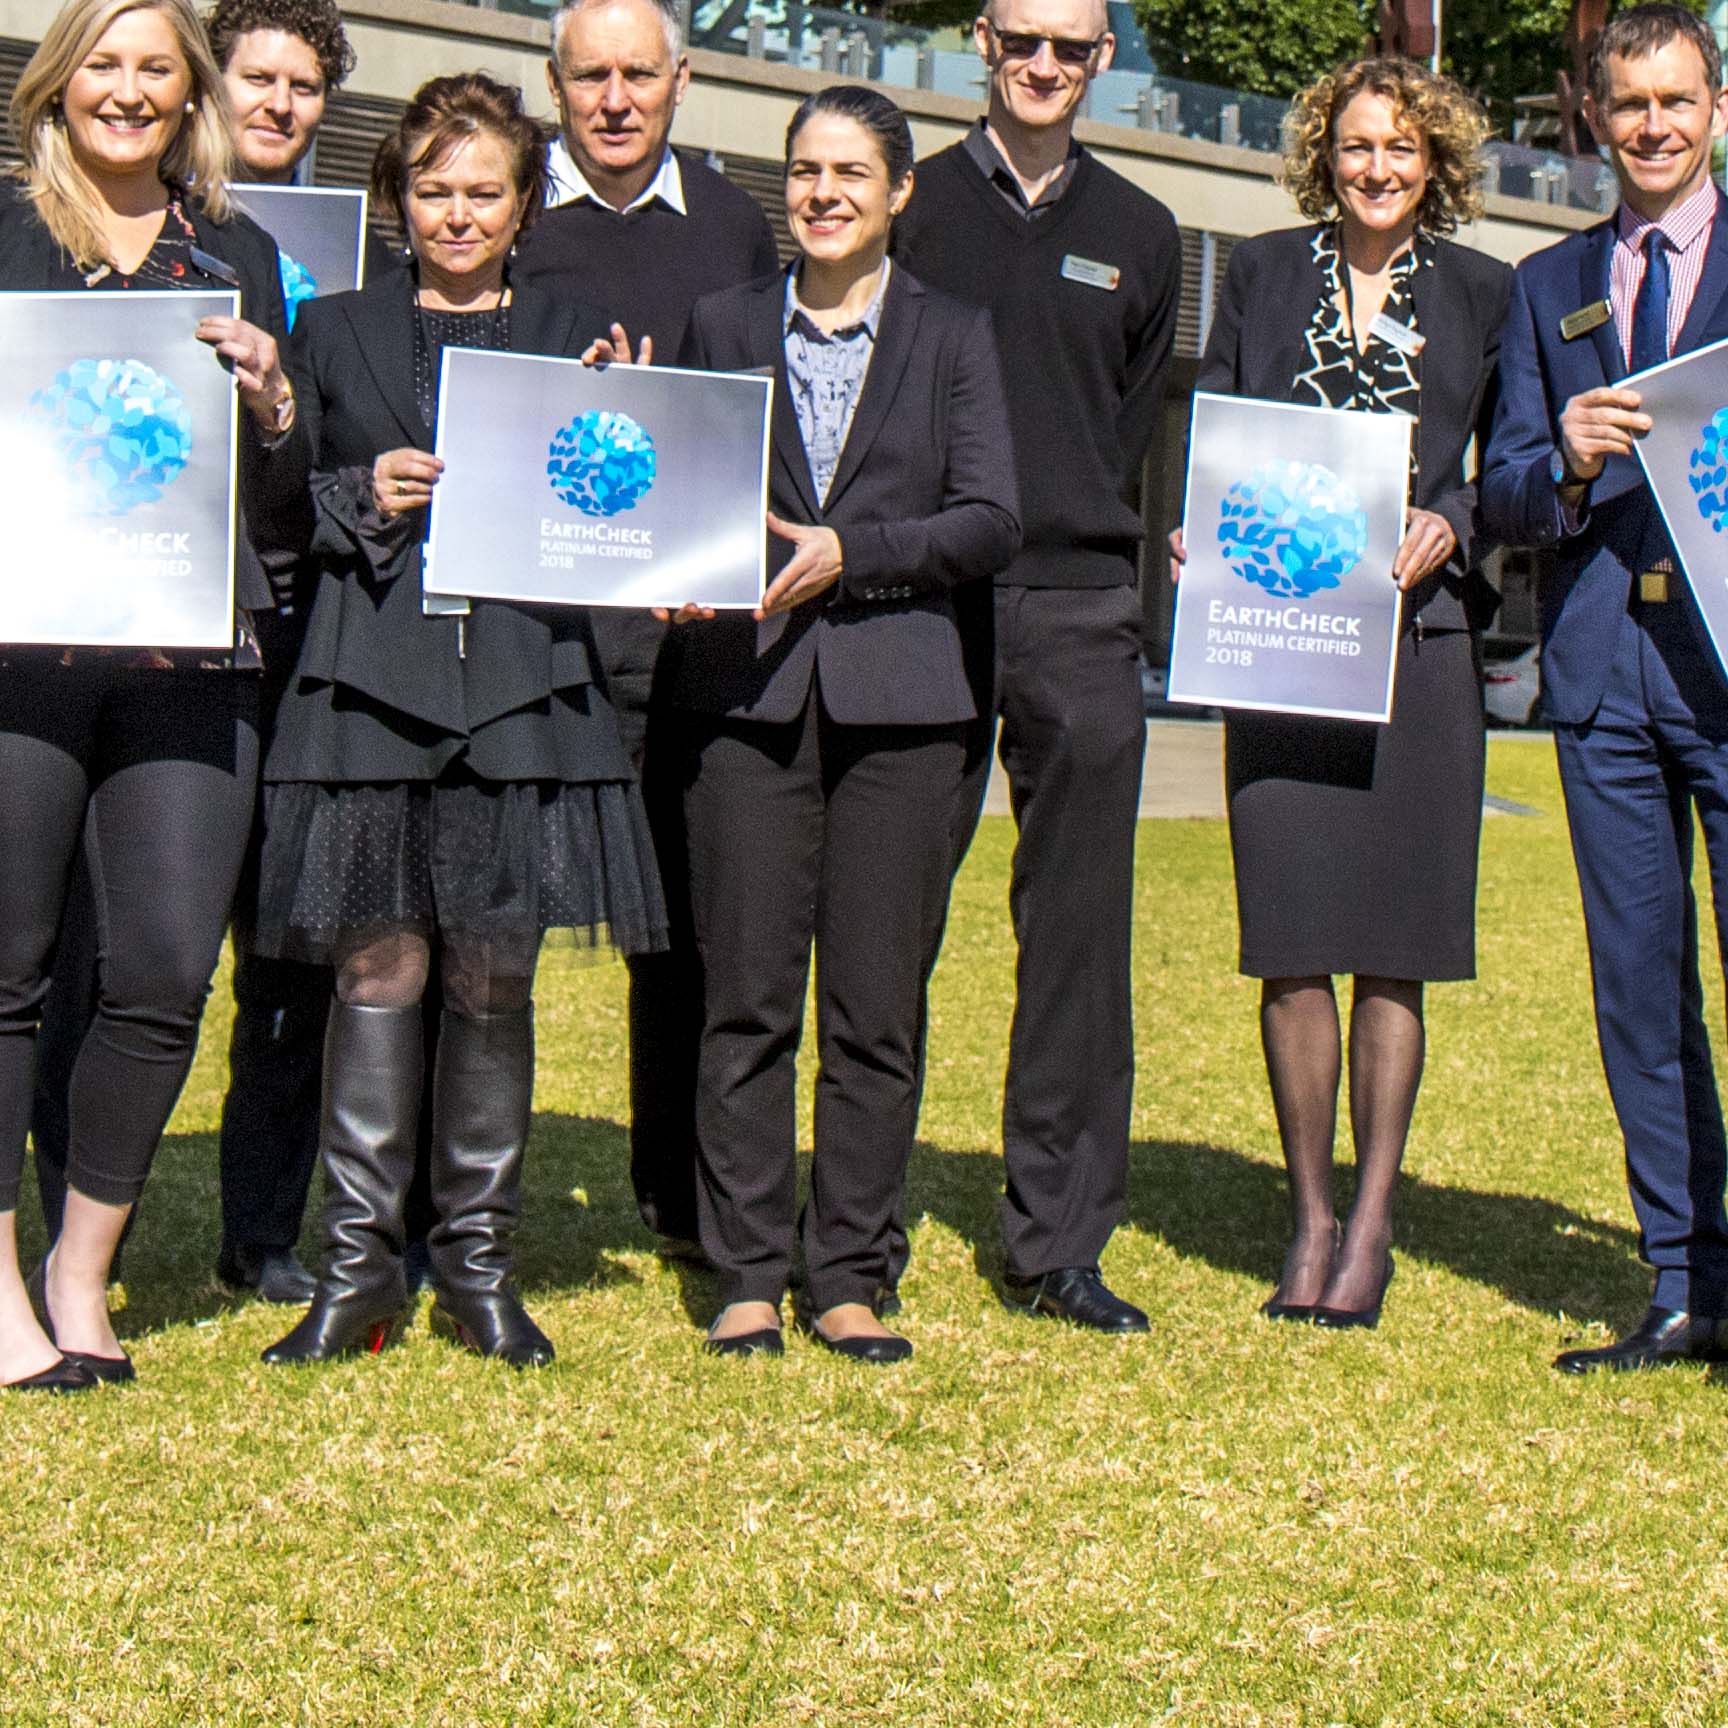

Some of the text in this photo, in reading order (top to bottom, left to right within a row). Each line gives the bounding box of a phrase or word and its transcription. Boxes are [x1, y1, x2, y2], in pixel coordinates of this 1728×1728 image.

[540, 518, 652, 544] EARTHCHECK
[538, 553, 574, 569] 2018
[540, 540, 653, 560] PLATINUM CERTIFIED
[1208, 599, 1361, 637] EARTHCHECK
[1207, 628, 1361, 657] PLATINUM CERTIFIED
[1205, 647, 1253, 667] 2018
